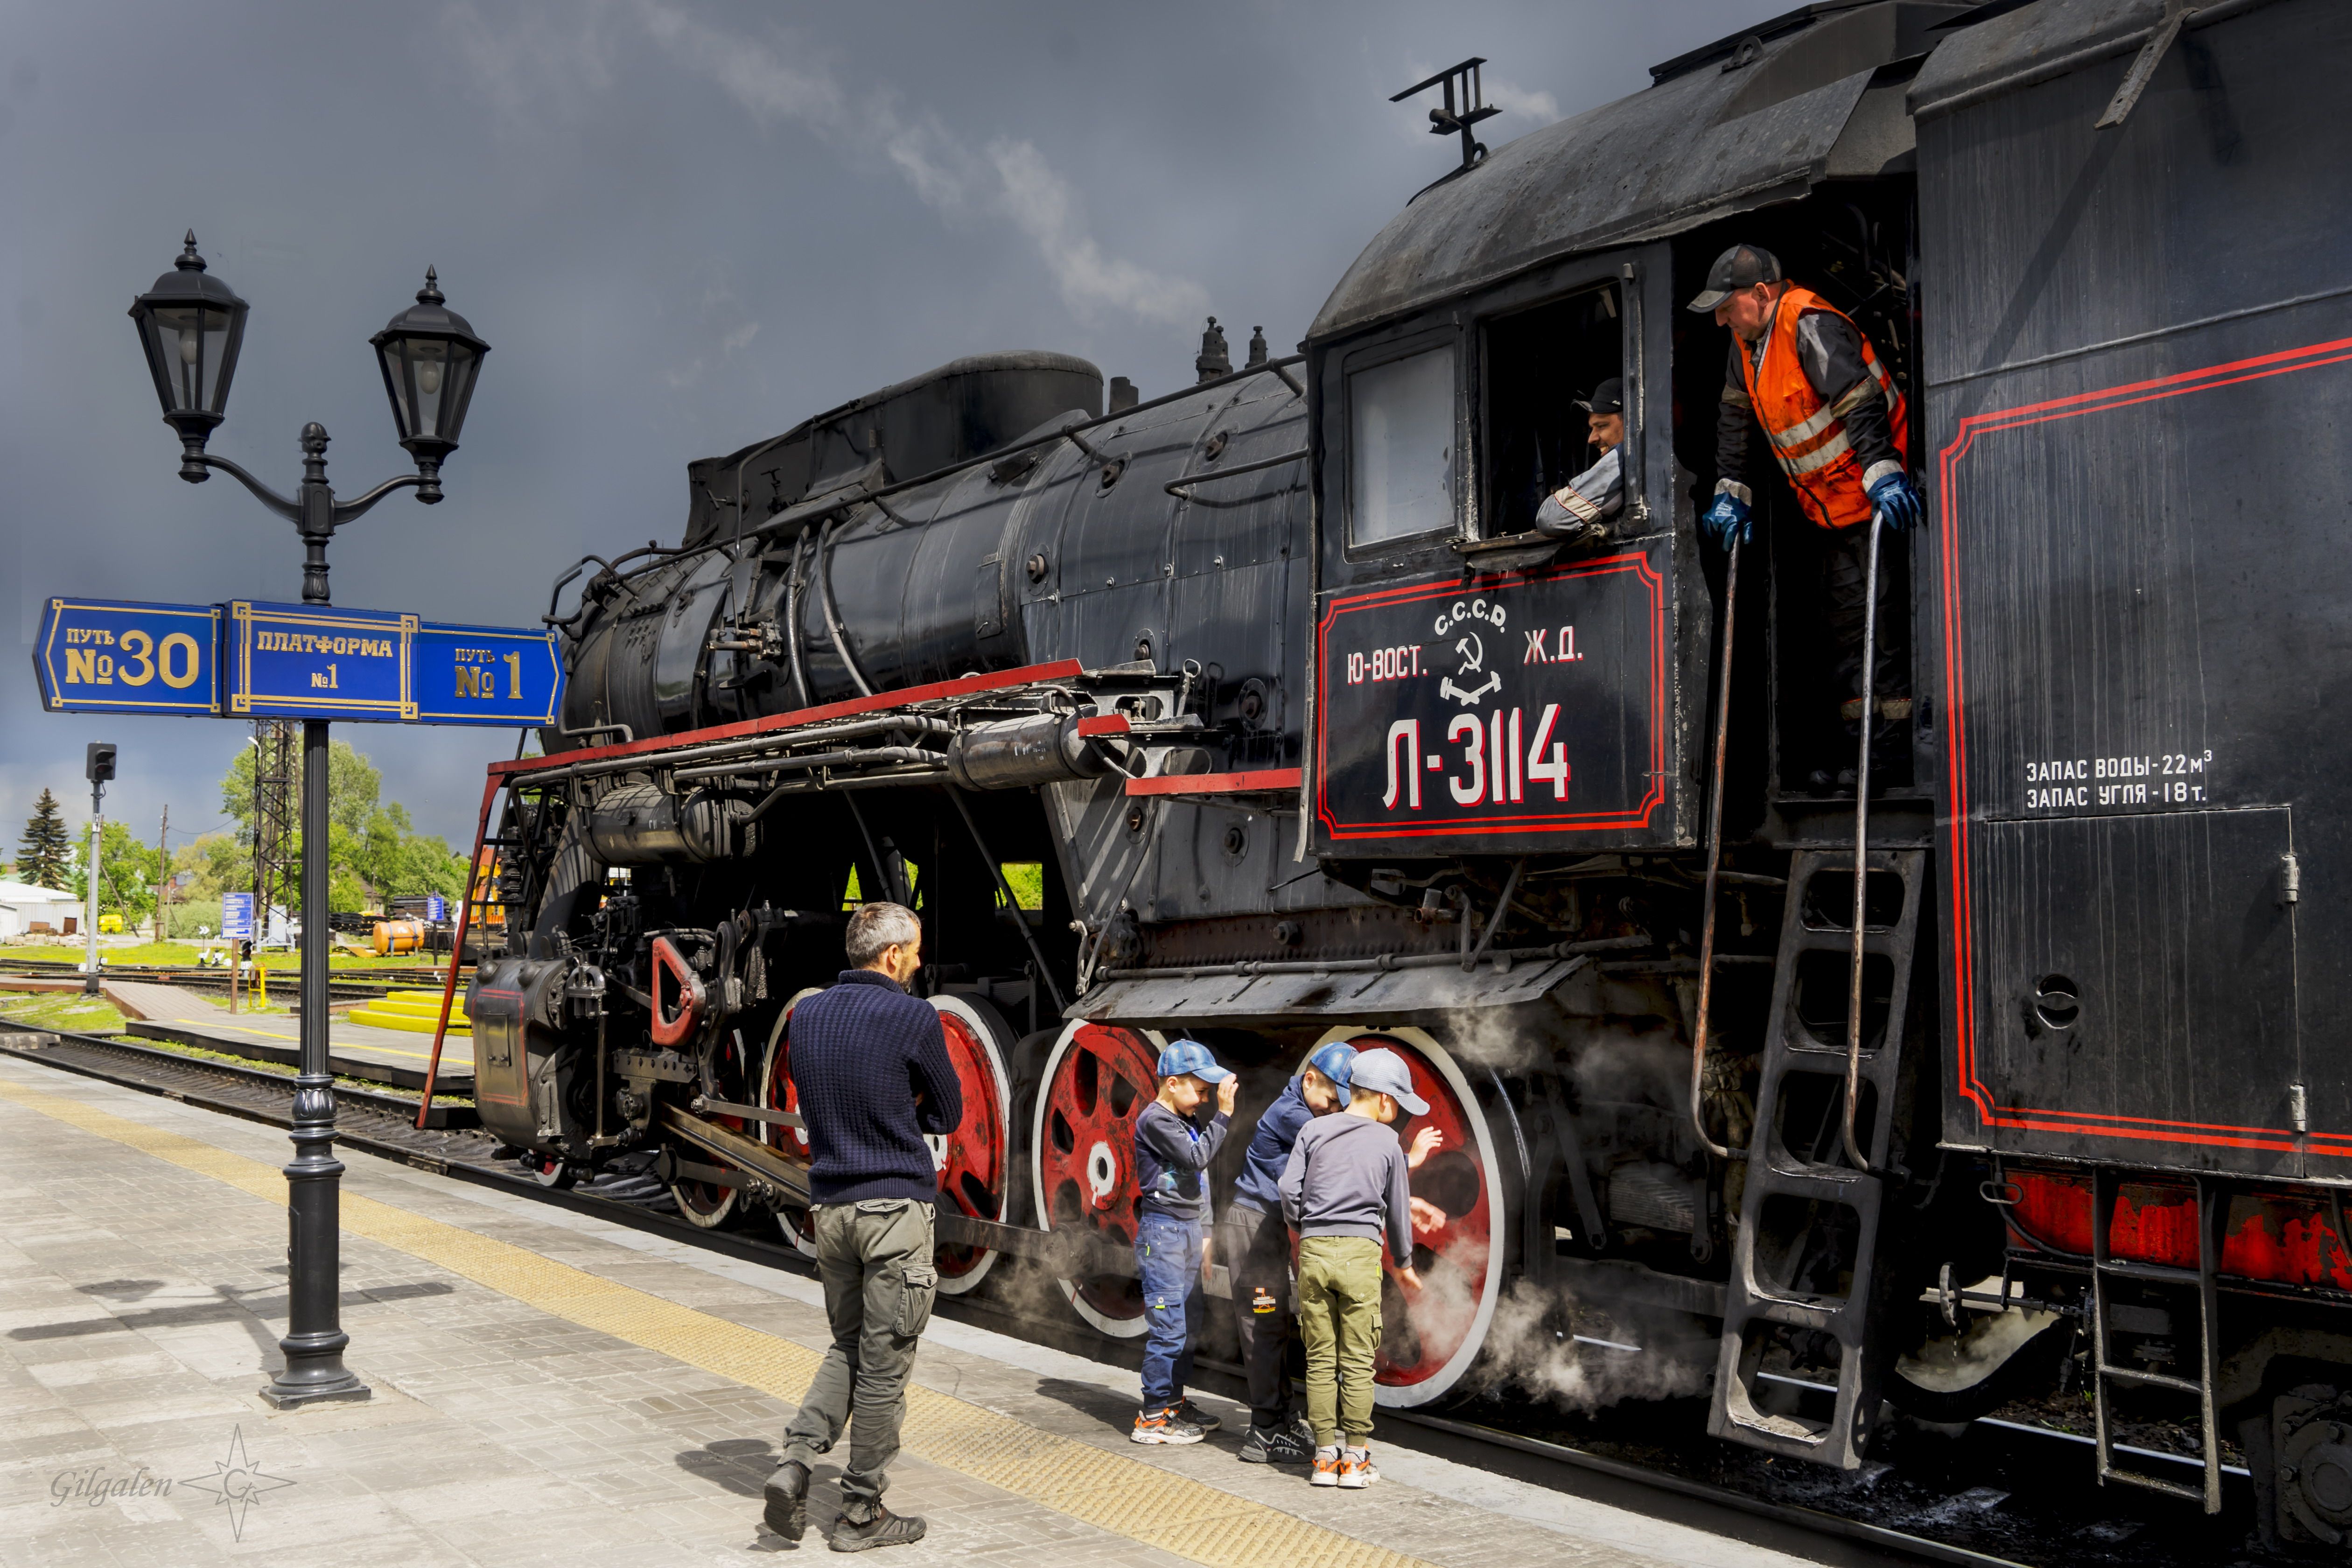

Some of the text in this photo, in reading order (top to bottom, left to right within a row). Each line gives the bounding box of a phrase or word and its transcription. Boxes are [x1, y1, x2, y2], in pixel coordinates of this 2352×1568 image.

[67, 628, 115, 645] ПУТЬ
[257, 631, 393, 657] ПЛАТФОРМА
[455, 648, 496, 663] ПУТЬ
[1348, 625, 1584, 685] Ю-ВОСТ. Ж.Д.
[1382, 703, 1571, 811] Л-3114
[2027, 759, 2087, 782] ЗАПАС
[2027, 787, 2088, 808] ЗАПАС
